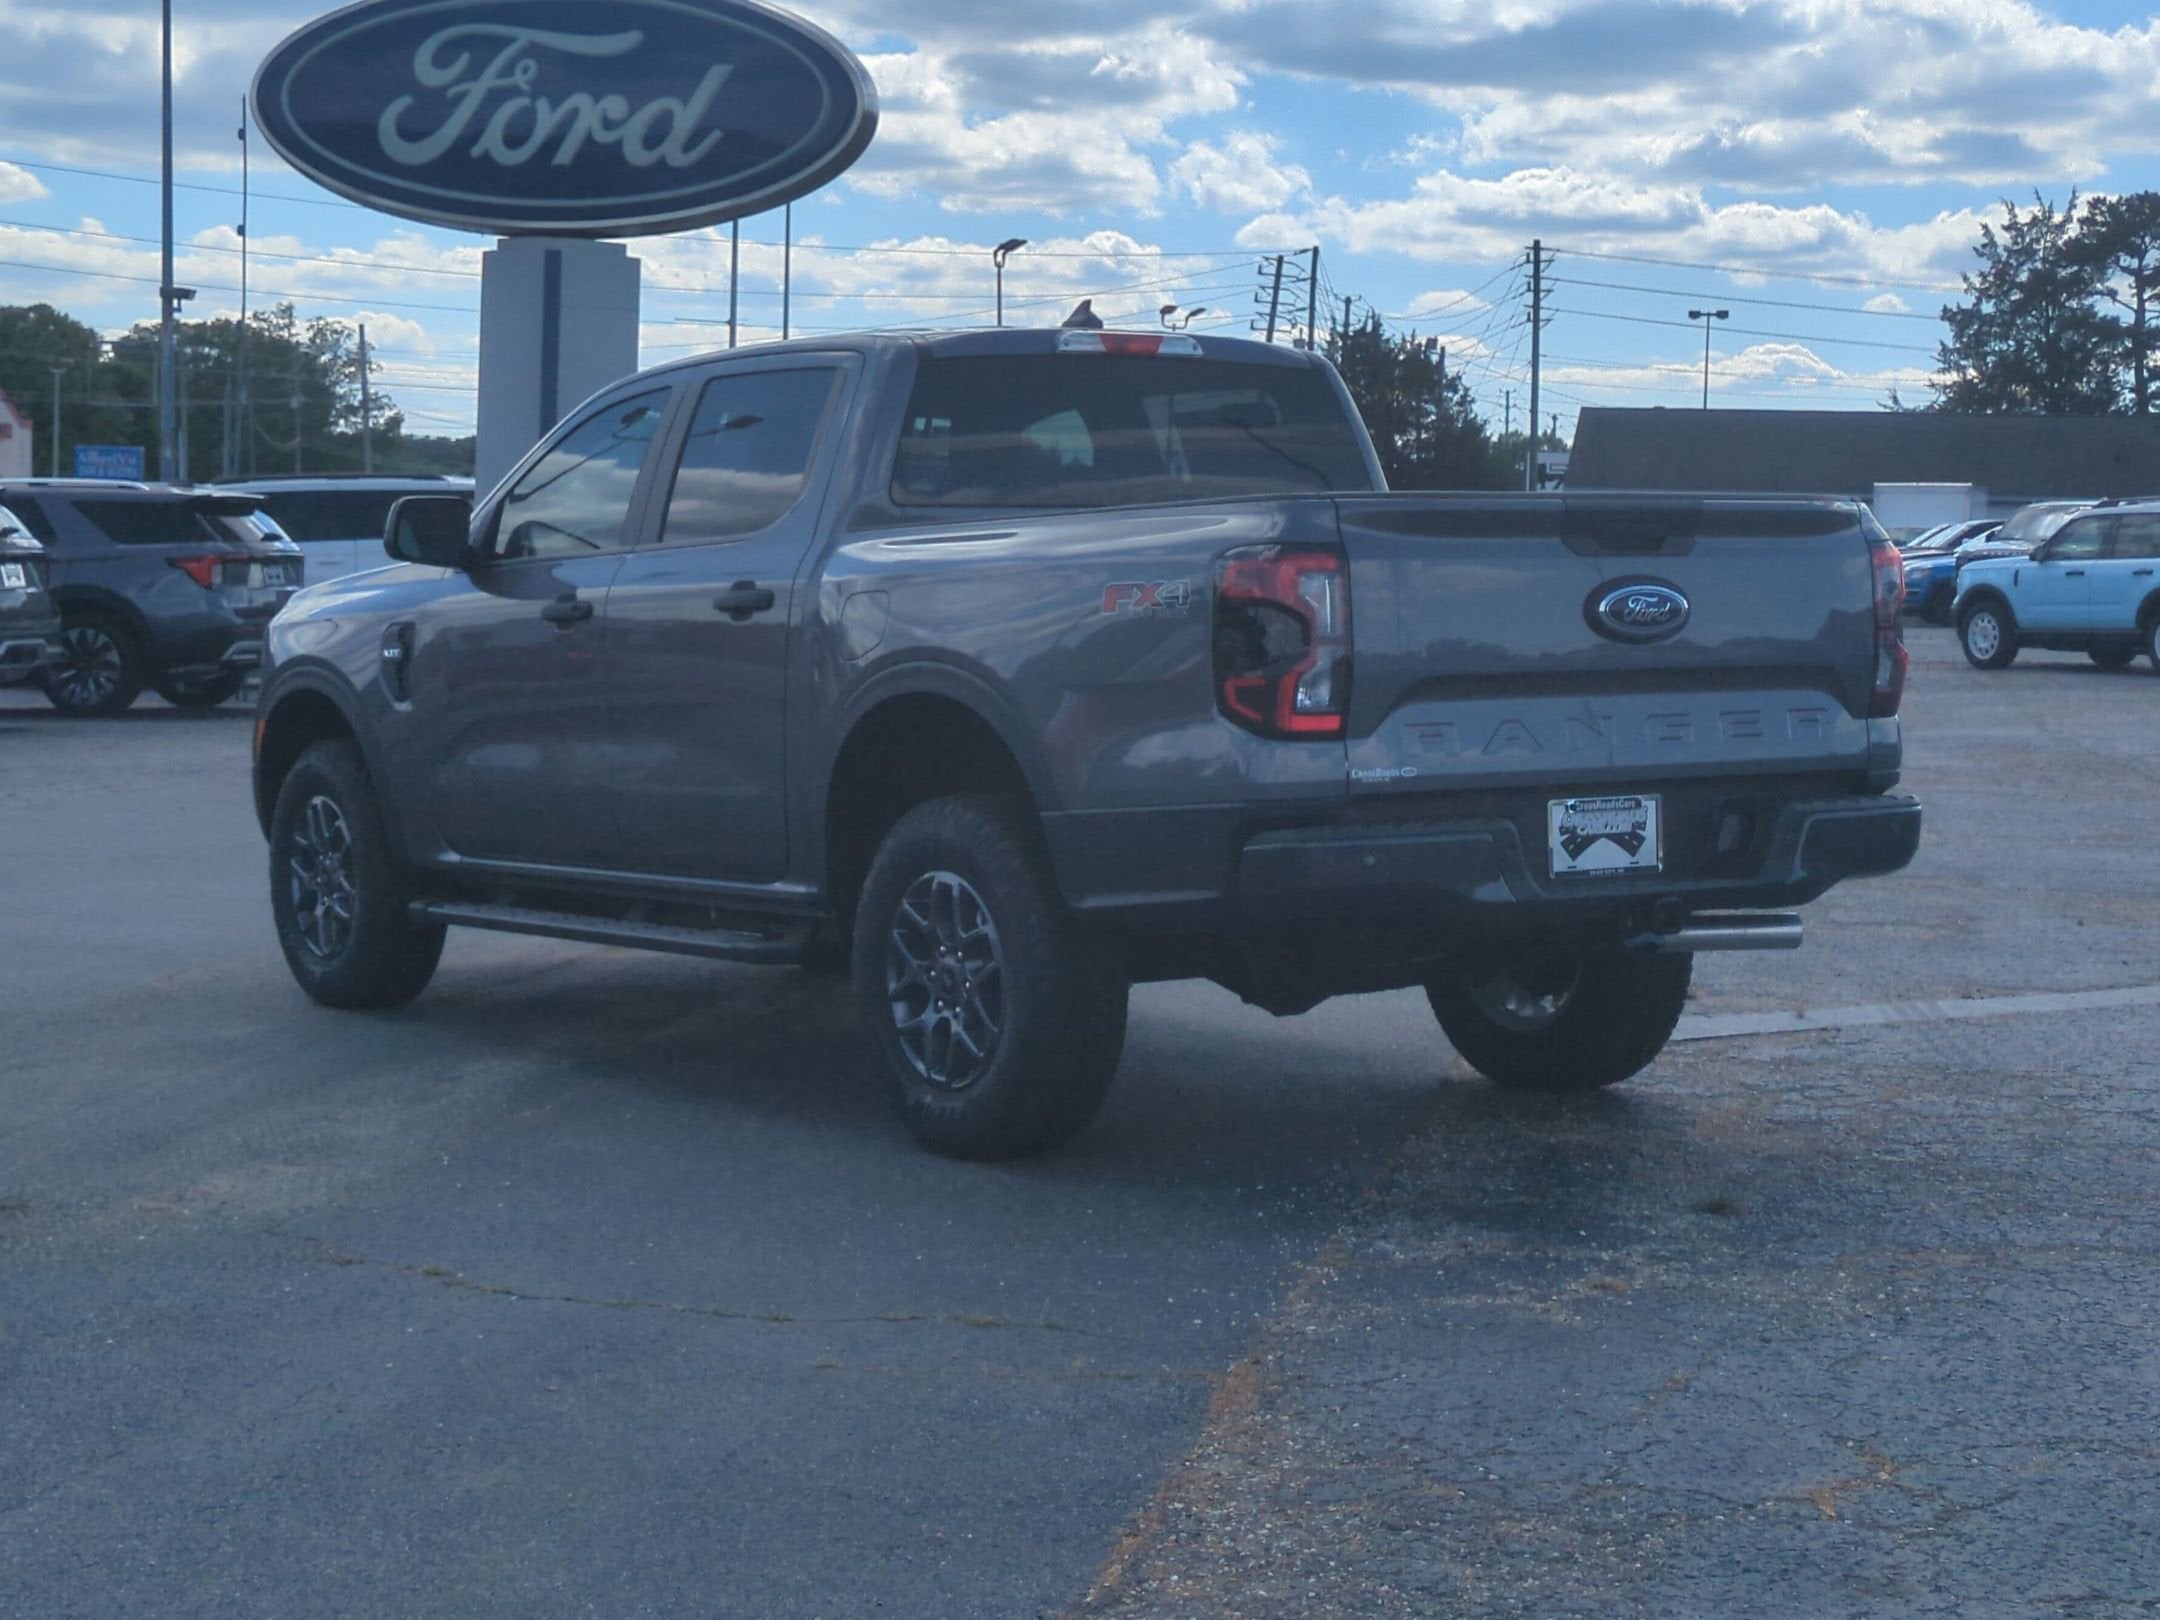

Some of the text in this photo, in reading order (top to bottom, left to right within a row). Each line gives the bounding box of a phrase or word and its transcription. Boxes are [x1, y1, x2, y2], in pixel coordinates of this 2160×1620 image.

[378, 24, 735, 167] Ford
[1102, 580, 1190, 615] FX4
[1624, 595, 1671, 622] Ford
[1404, 707, 1829, 757] RANGER
